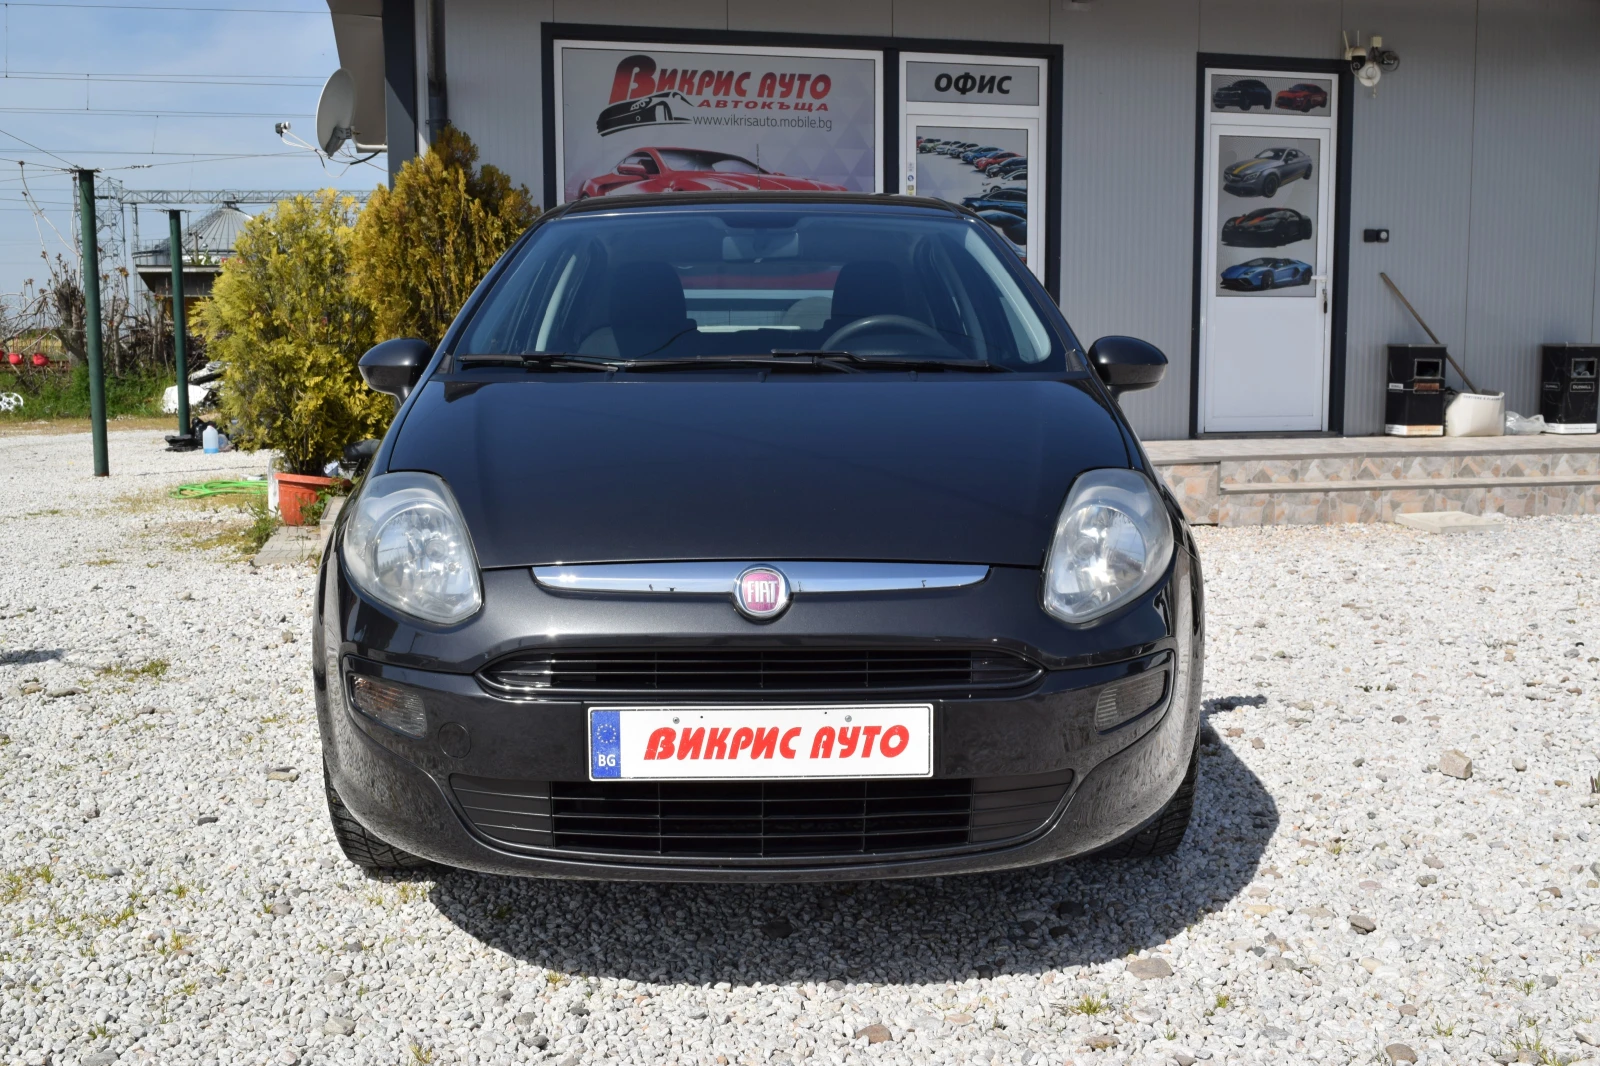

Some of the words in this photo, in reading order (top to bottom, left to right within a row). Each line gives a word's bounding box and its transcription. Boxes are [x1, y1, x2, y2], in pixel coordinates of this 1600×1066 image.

[608, 54, 751, 105] ВИКРИС
[757, 71, 832, 100] АУТО
[934, 72, 1012, 95] ОФИС
[697, 99, 829, 112] АВТОКЪЩА
[692, 114, 832, 131] www.vikrisauto.mobile.bg
[747, 580, 778, 603] FIAT
[643, 726, 802, 761] ВИКРИС
[809, 724, 910, 759] АУТО
[598, 754, 616, 767] BG
